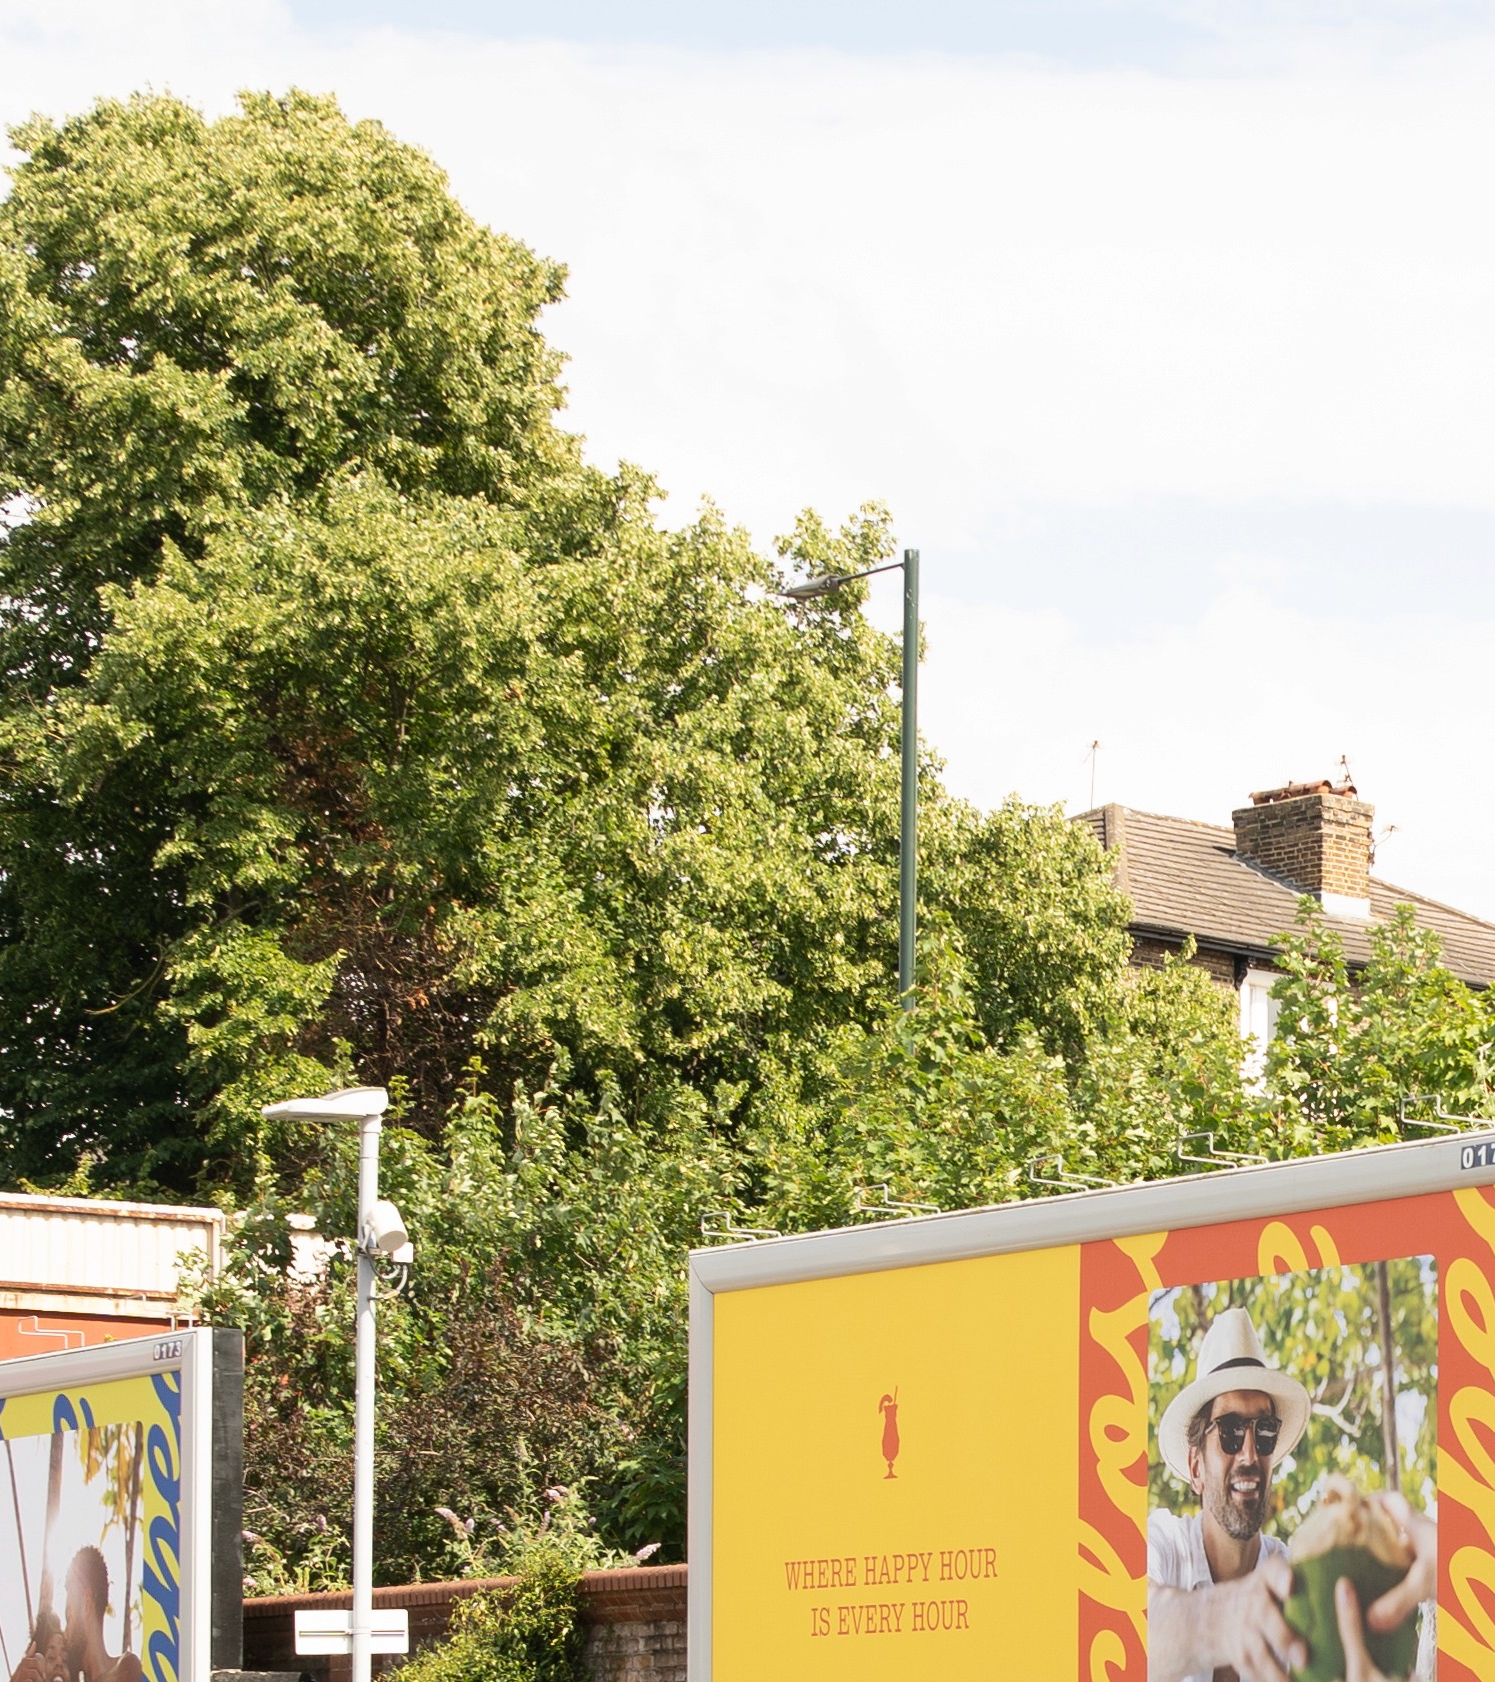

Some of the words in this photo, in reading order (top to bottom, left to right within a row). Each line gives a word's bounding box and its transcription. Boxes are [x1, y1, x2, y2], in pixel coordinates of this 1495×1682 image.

[154, 1341, 182, 1360] 0173
[784, 1557, 857, 1591] WHERE
[863, 1552, 933, 1586] HAPPY
[939, 1548, 998, 1581] HOUR
[810, 1607, 831, 1637] IS
[837, 1603, 906, 1636] EVERY
[911, 1599, 970, 1632] HOUR
